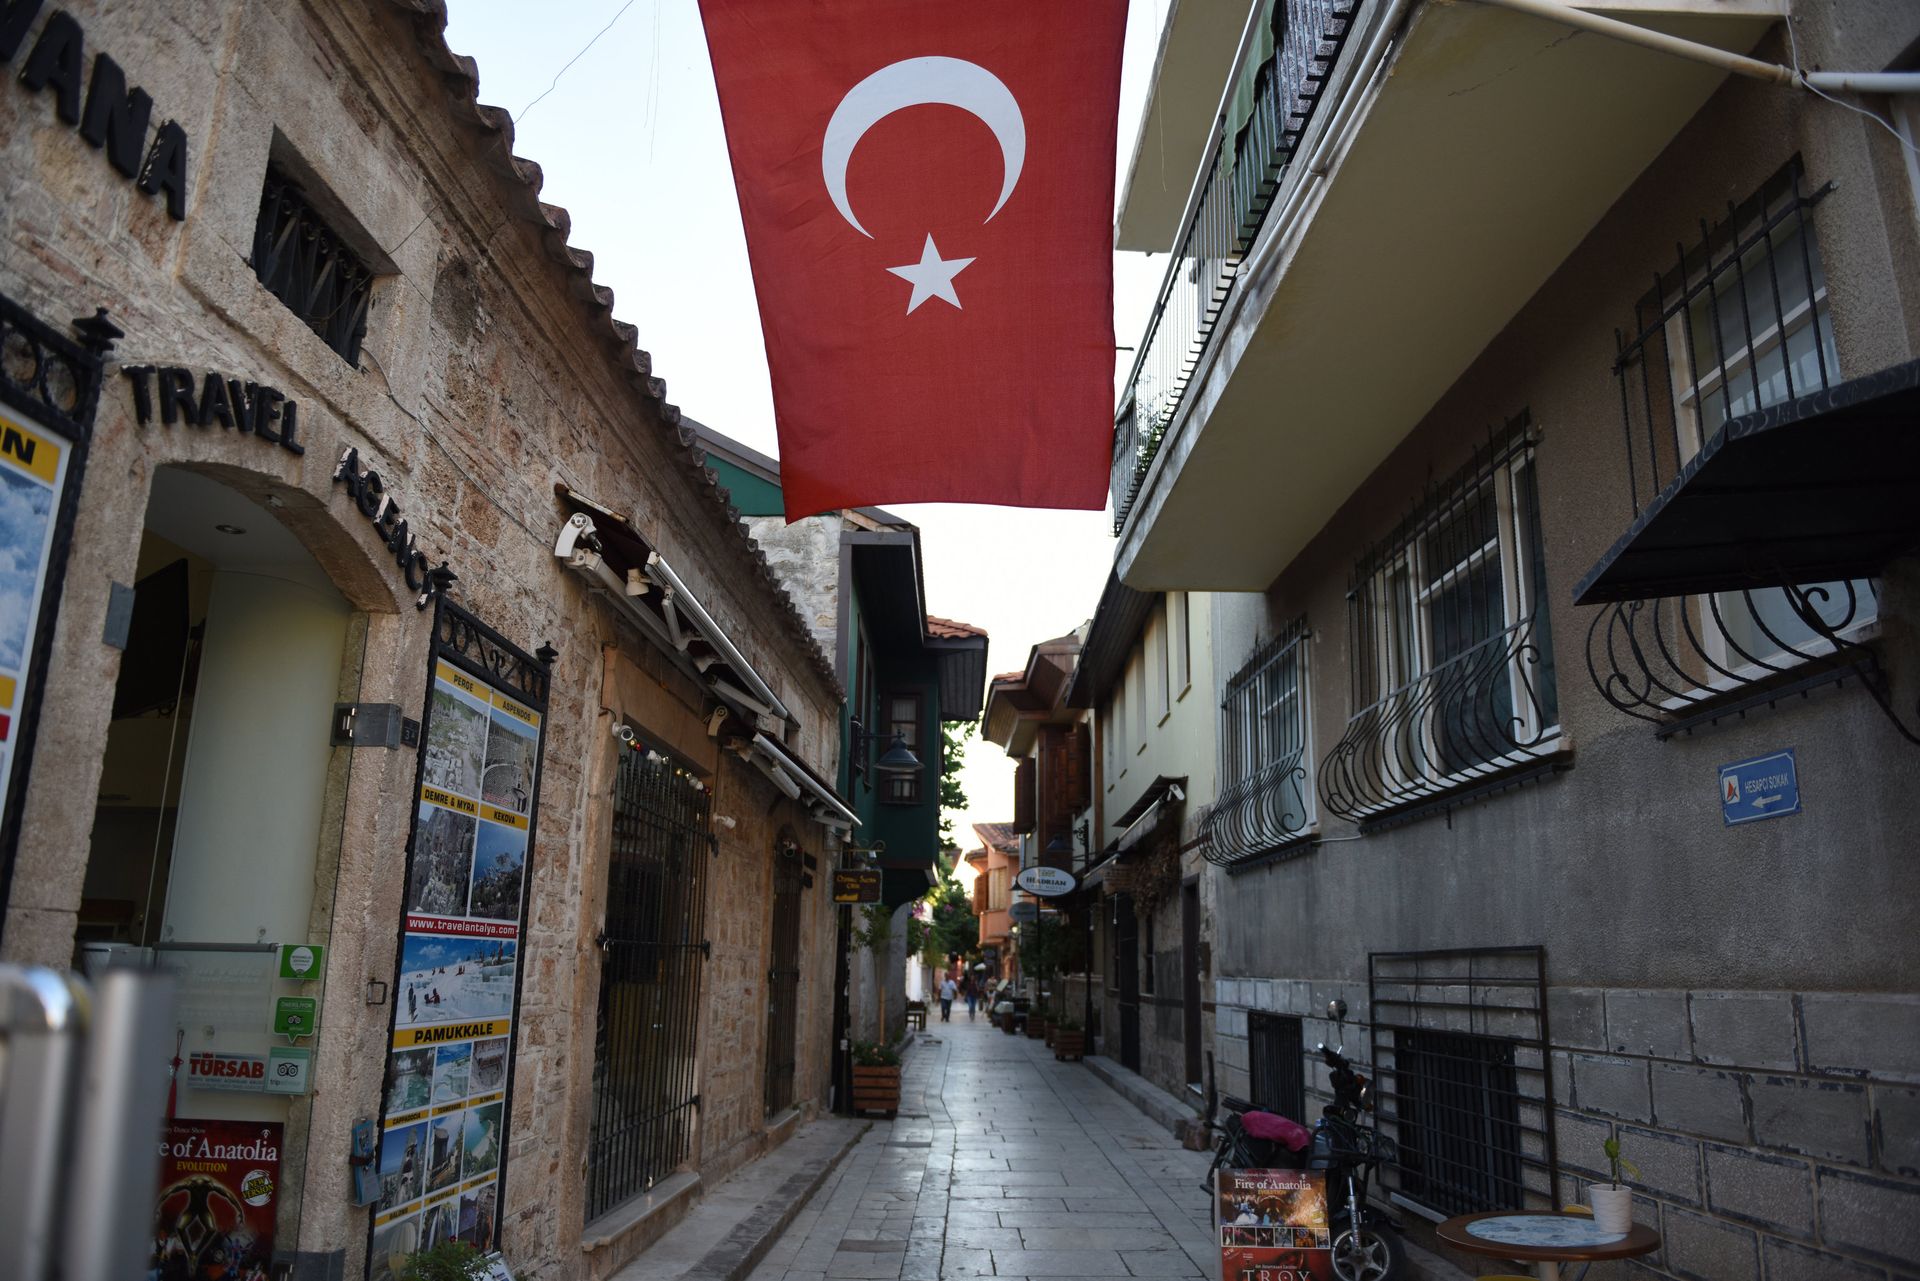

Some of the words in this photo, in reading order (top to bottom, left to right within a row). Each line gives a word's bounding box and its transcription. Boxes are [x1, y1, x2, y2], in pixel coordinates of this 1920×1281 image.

[121, 363, 304, 455] TRAVEL
[333, 447, 434, 611] AGENCY
[453, 674, 474, 692] PERGE
[502, 701, 531, 721] ASPENDOS
[1769, 773, 1789, 789] SOKAK
[424, 789, 449, 805] DEMRE
[450, 798, 455, 807] &
[457, 799, 475, 812] MYRA
[493, 810, 516, 824] KEKOVA
[409, 919, 515, 935] www.travelantalya.com
[414, 1023, 493, 1043] PAMUKKALE
[189, 1053, 265, 1078] TÜRSAB
[172, 1136, 197, 1158] of
[194, 1137, 278, 1161] Anatolia
[176, 1161, 228, 1173] EVOLUTION
[242, 1183, 274, 1199] VERSION
[1234, 1178, 1255, 1189] Fire
[1256, 1179, 1268, 1189] of
[1270, 1179, 1312, 1190] Anatolia
[1242, 1269, 1312, 1281] TROY
